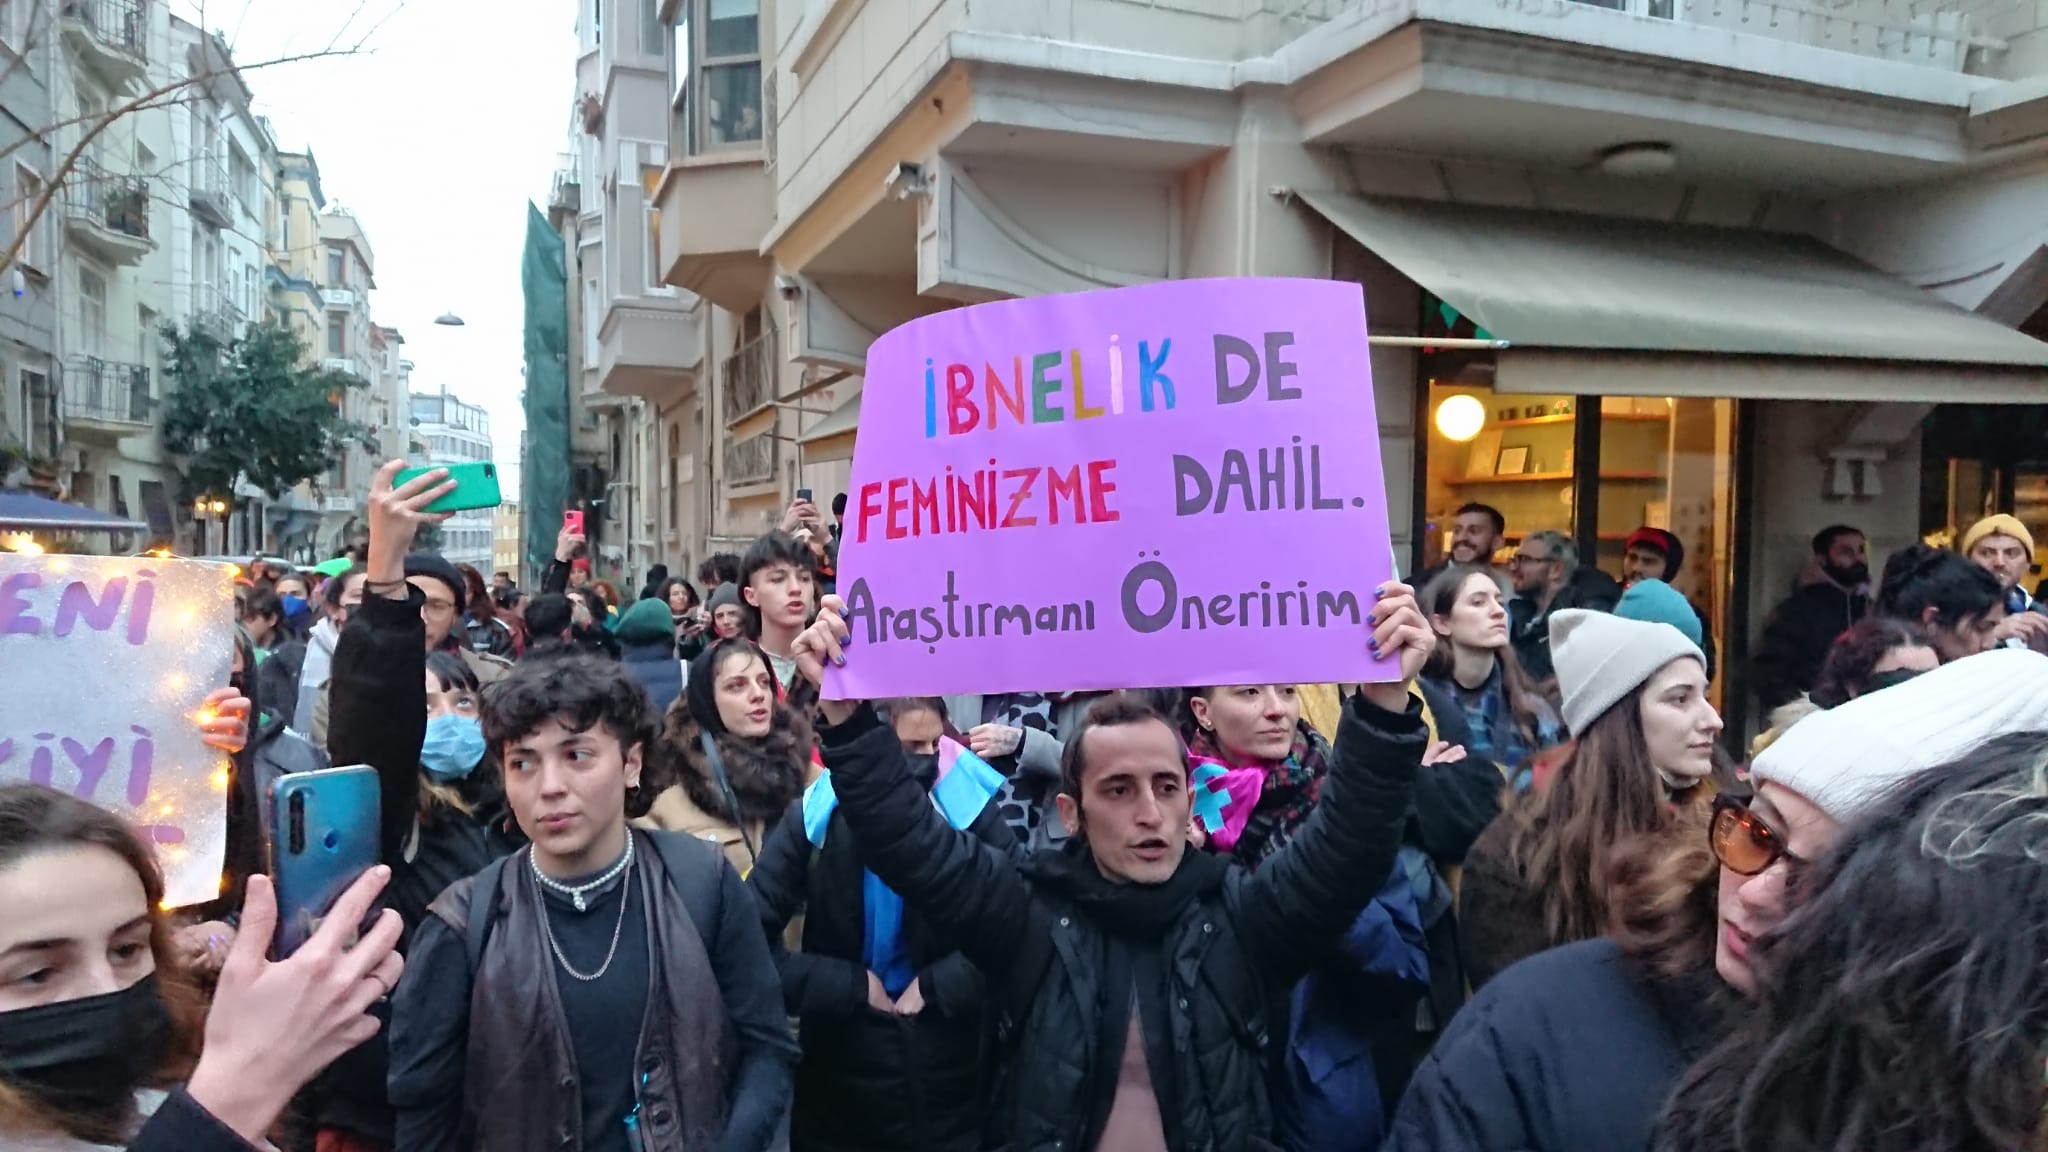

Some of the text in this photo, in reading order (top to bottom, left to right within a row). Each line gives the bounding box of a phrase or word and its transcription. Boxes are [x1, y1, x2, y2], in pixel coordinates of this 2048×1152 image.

[924, 331, 1302, 438] İBNELİK DE
[856, 436, 1364, 543] FEMİNİZME DAHİL.
[846, 551, 1361, 654] Araştırmanı Öneririm
[0, 725, 153, 806] İYİ
